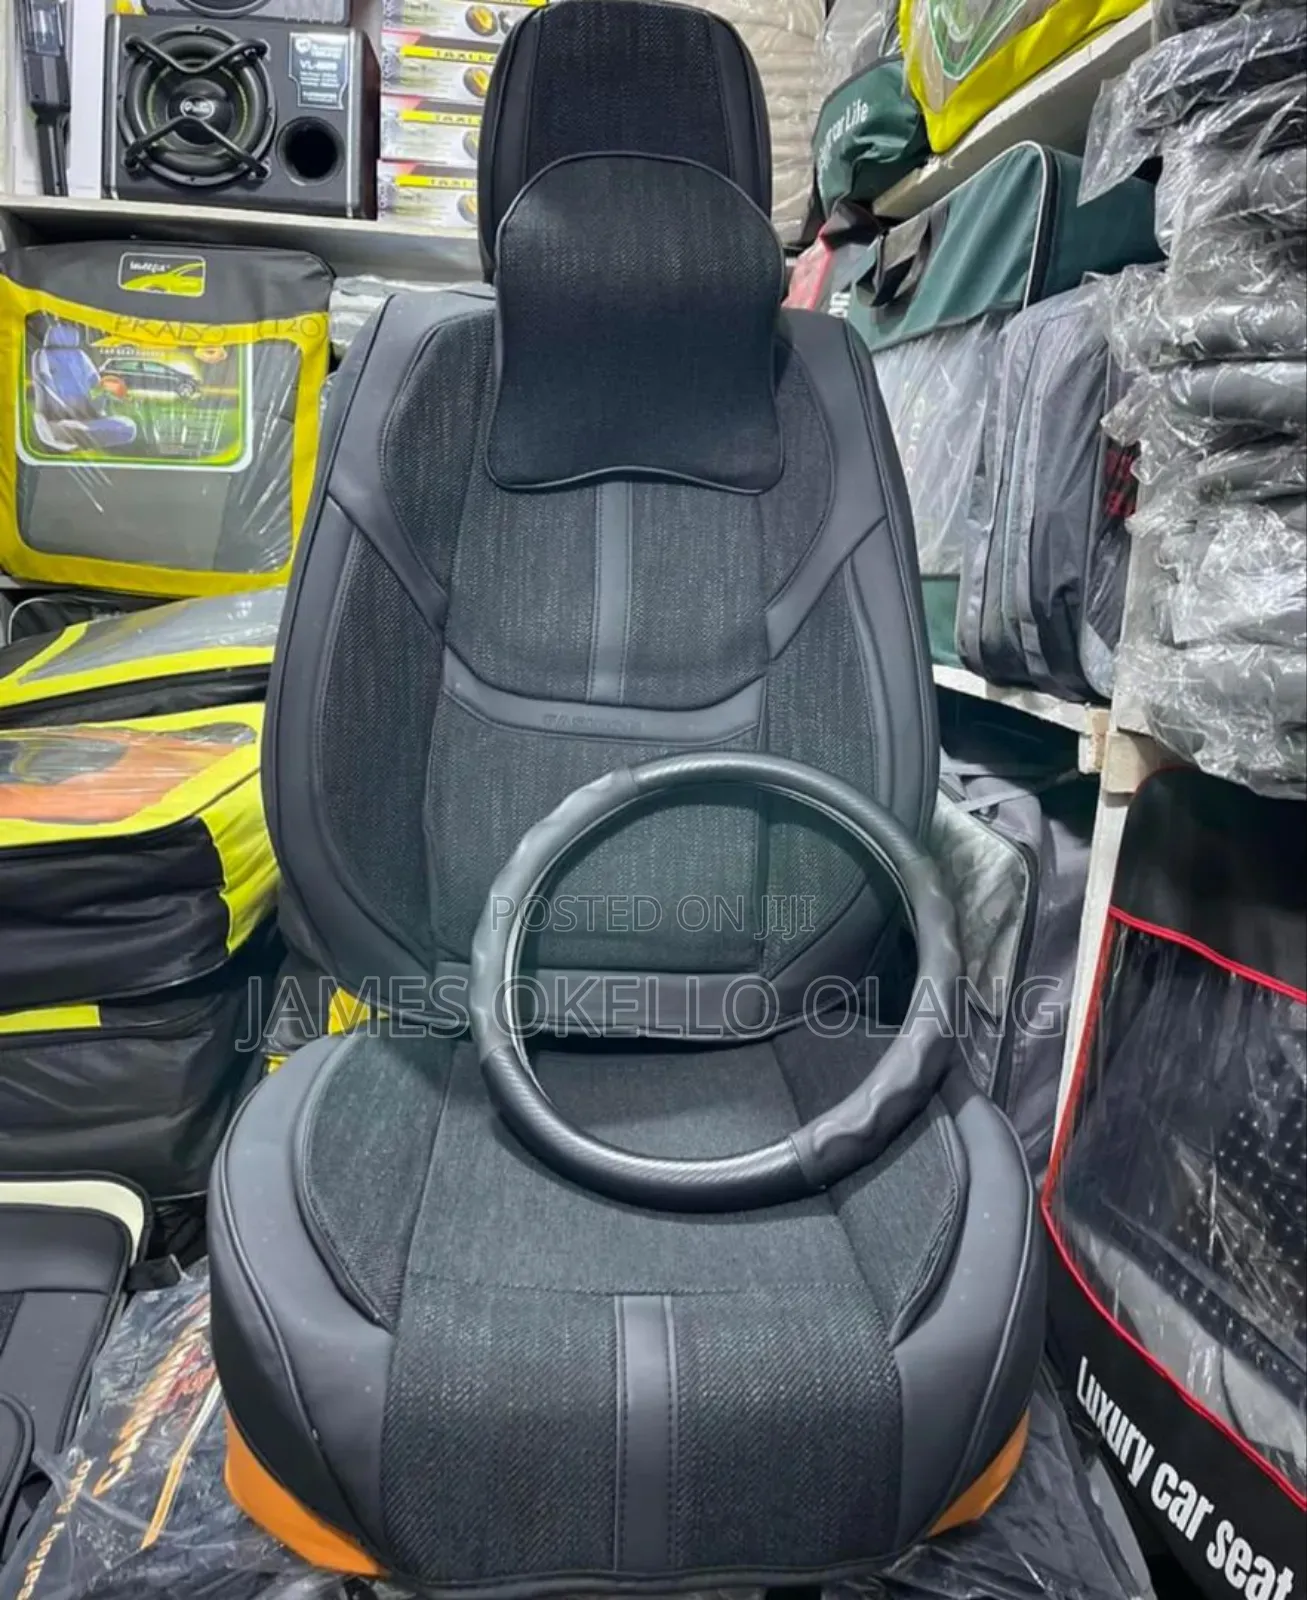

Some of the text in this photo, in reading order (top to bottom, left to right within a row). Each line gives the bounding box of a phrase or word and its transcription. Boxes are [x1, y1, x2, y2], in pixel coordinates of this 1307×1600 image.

[845, 98, 869, 132] Life
[113, 314, 226, 345] PRADO
[1077, 1355, 1294, 1600] Luxury car seat
